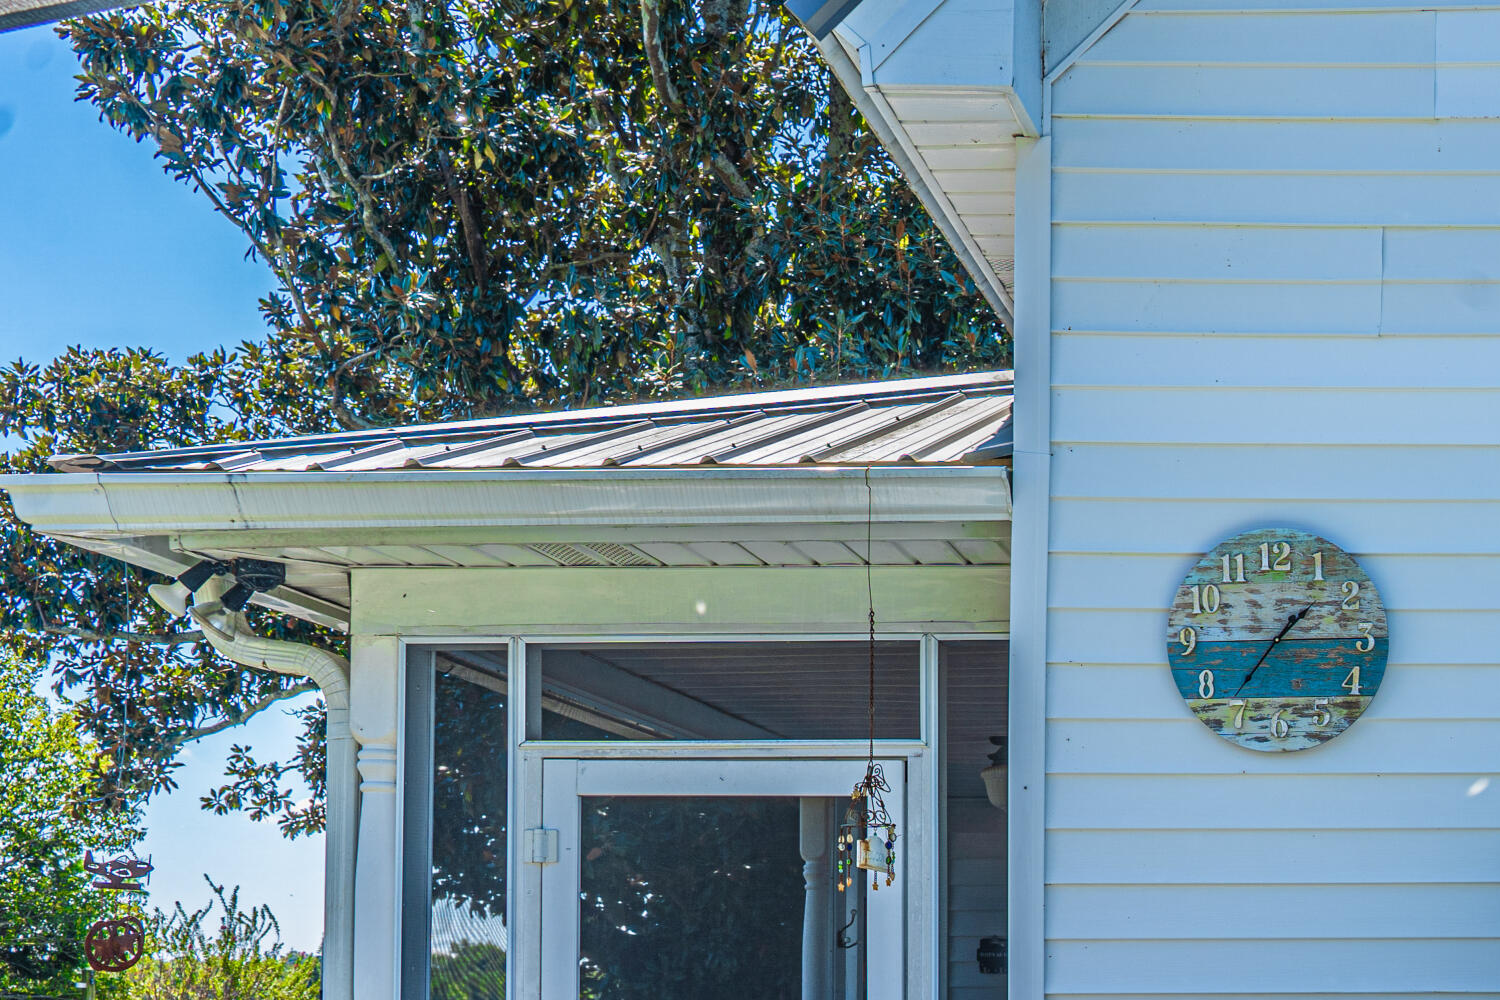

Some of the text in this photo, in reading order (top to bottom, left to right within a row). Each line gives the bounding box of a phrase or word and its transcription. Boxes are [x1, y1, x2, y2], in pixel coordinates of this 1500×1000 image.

[1221, 553, 1247, 583] 11
[1259, 542, 1291, 571] 12
[1312, 552, 1324, 581] 1
[1191, 584, 1221, 614] 10
[1341, 581, 1360, 610] 2
[1179, 627, 1196, 656] 9
[1356, 623, 1375, 652] 3
[1198, 669, 1215, 699] 8
[1341, 666, 1363, 695] 4
[1229, 699, 1247, 729] 7
[1270, 709, 1289, 738] 6
[1312, 698, 1331, 727] 5
